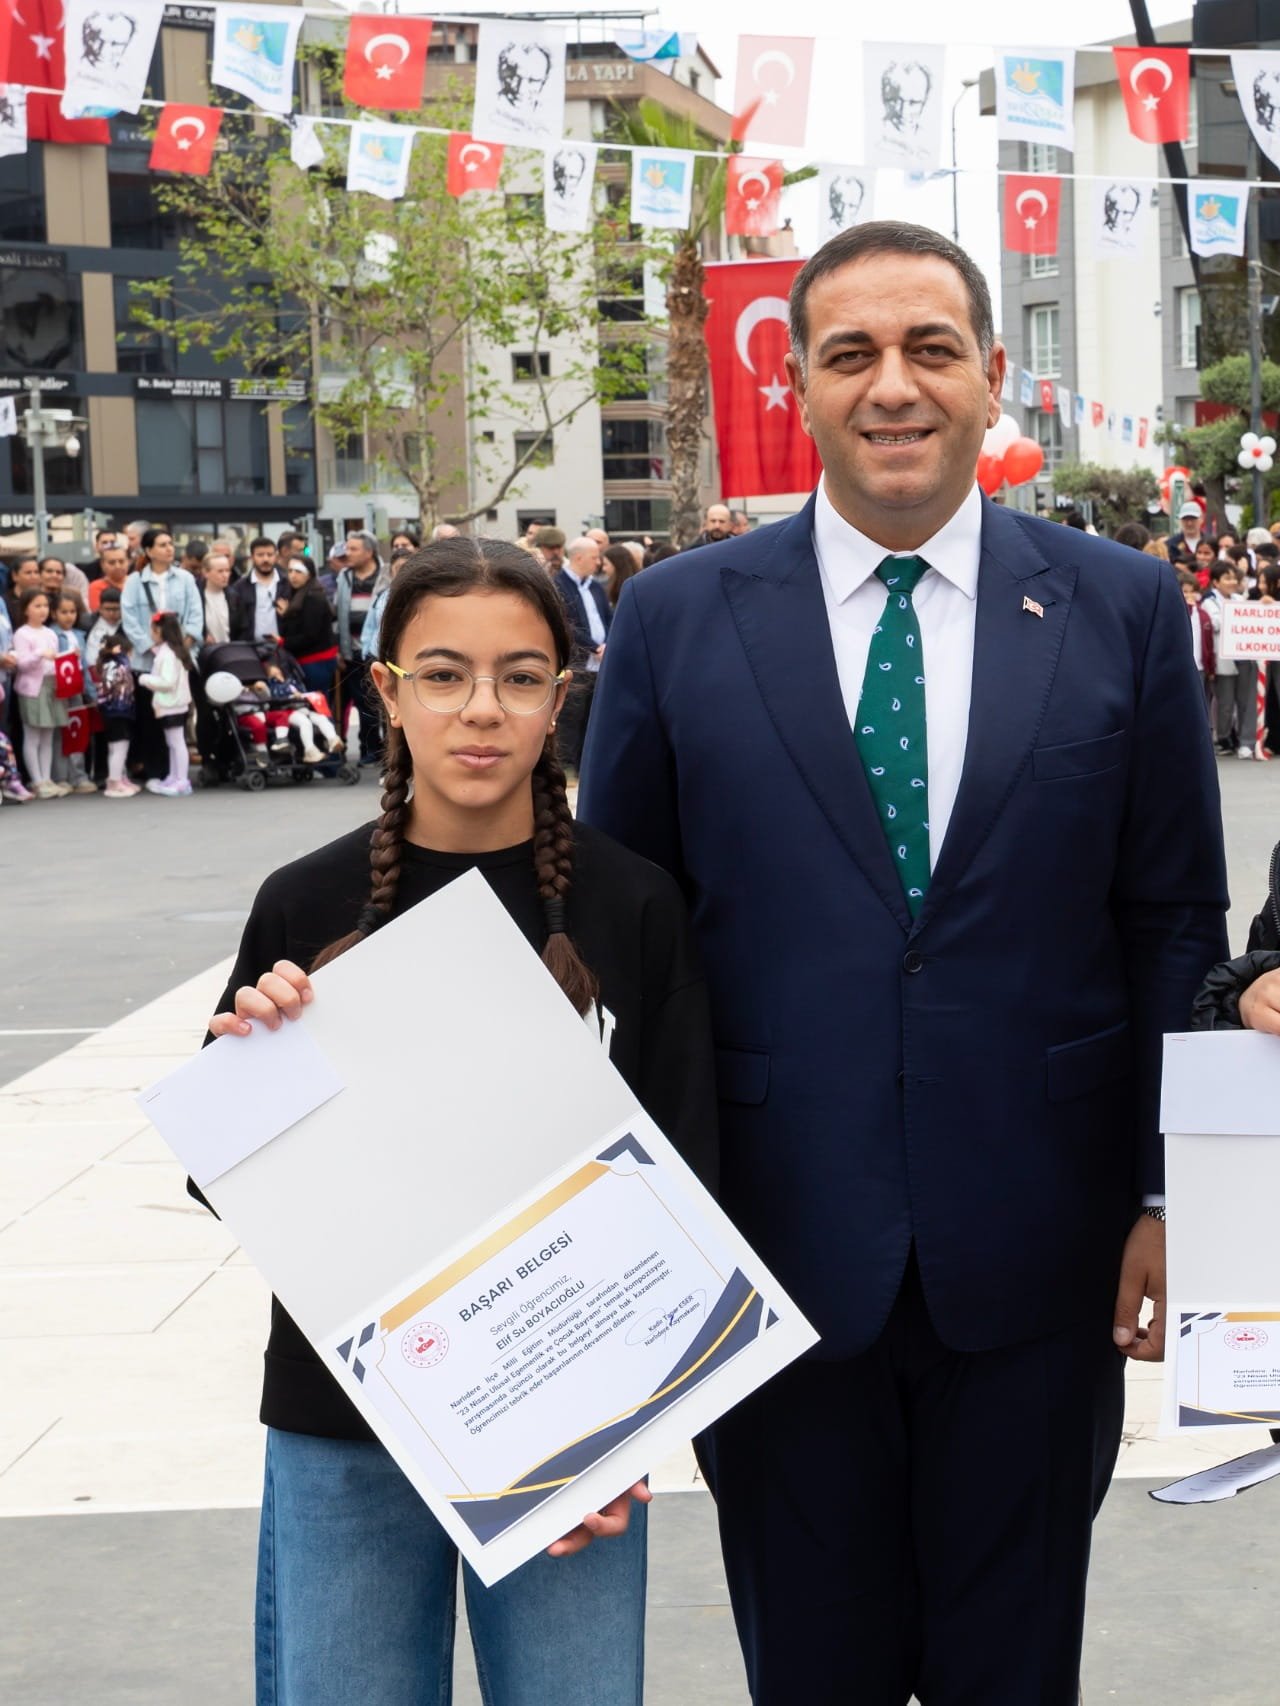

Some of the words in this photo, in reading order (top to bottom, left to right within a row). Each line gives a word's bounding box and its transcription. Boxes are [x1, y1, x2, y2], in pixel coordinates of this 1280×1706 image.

[1231, 624, 1264, 634] İLHAN
[449, 1385, 482, 1409] Narlıdere
[484, 1372, 499, 1384] İlçe
[501, 1356, 518, 1371] Milli
[521, 1338, 544, 1357] Eğitim
[546, 1308, 583, 1337] Müdürlüğü
[585, 1281, 620, 1308] tarafından
[623, 1250, 660, 1280] düzenlenen
[458, 1277, 514, 1322] BAŞARI
[515, 1230, 573, 1280] BELGESİ
[489, 1310, 521, 1336] Sevgili
[519, 1274, 572, 1314] Öğrencimiz,
[495, 1333, 513, 1350] Elif
[511, 1326, 527, 1338] Su
[524, 1279, 585, 1329] BOYACIOĞLU
[463, 1393, 508, 1429] yarışmasında
[508, 1373, 534, 1393] üçüncü
[535, 1356, 556, 1374] olarak
[556, 1347, 568, 1357] bu
[567, 1327, 593, 1349] belgeyi
[594, 1309, 618, 1329] almaya
[617, 1298, 633, 1310] hak
[632, 1268, 673, 1299] kazanmıştır.
[469, 1392, 490, 1409] Nisan
[488, 1375, 511, 1394] Ulusal
[509, 1351, 545, 1379] Egemenlik
[544, 1344, 554, 1353] ve
[553, 1328, 575, 1347] Çocuk
[602, 1290, 625, 1308] temalı
[623, 1258, 666, 1293] kompozisyon
[469, 1403, 510, 1435] Öğrencimizi
[508, 1390, 529, 1407] tebrik
[528, 1378, 544, 1392] eder
[542, 1348, 584, 1381] başarılarının
[583, 1326, 613, 1351] devamını
[612, 1309, 637, 1329] dilerim.
